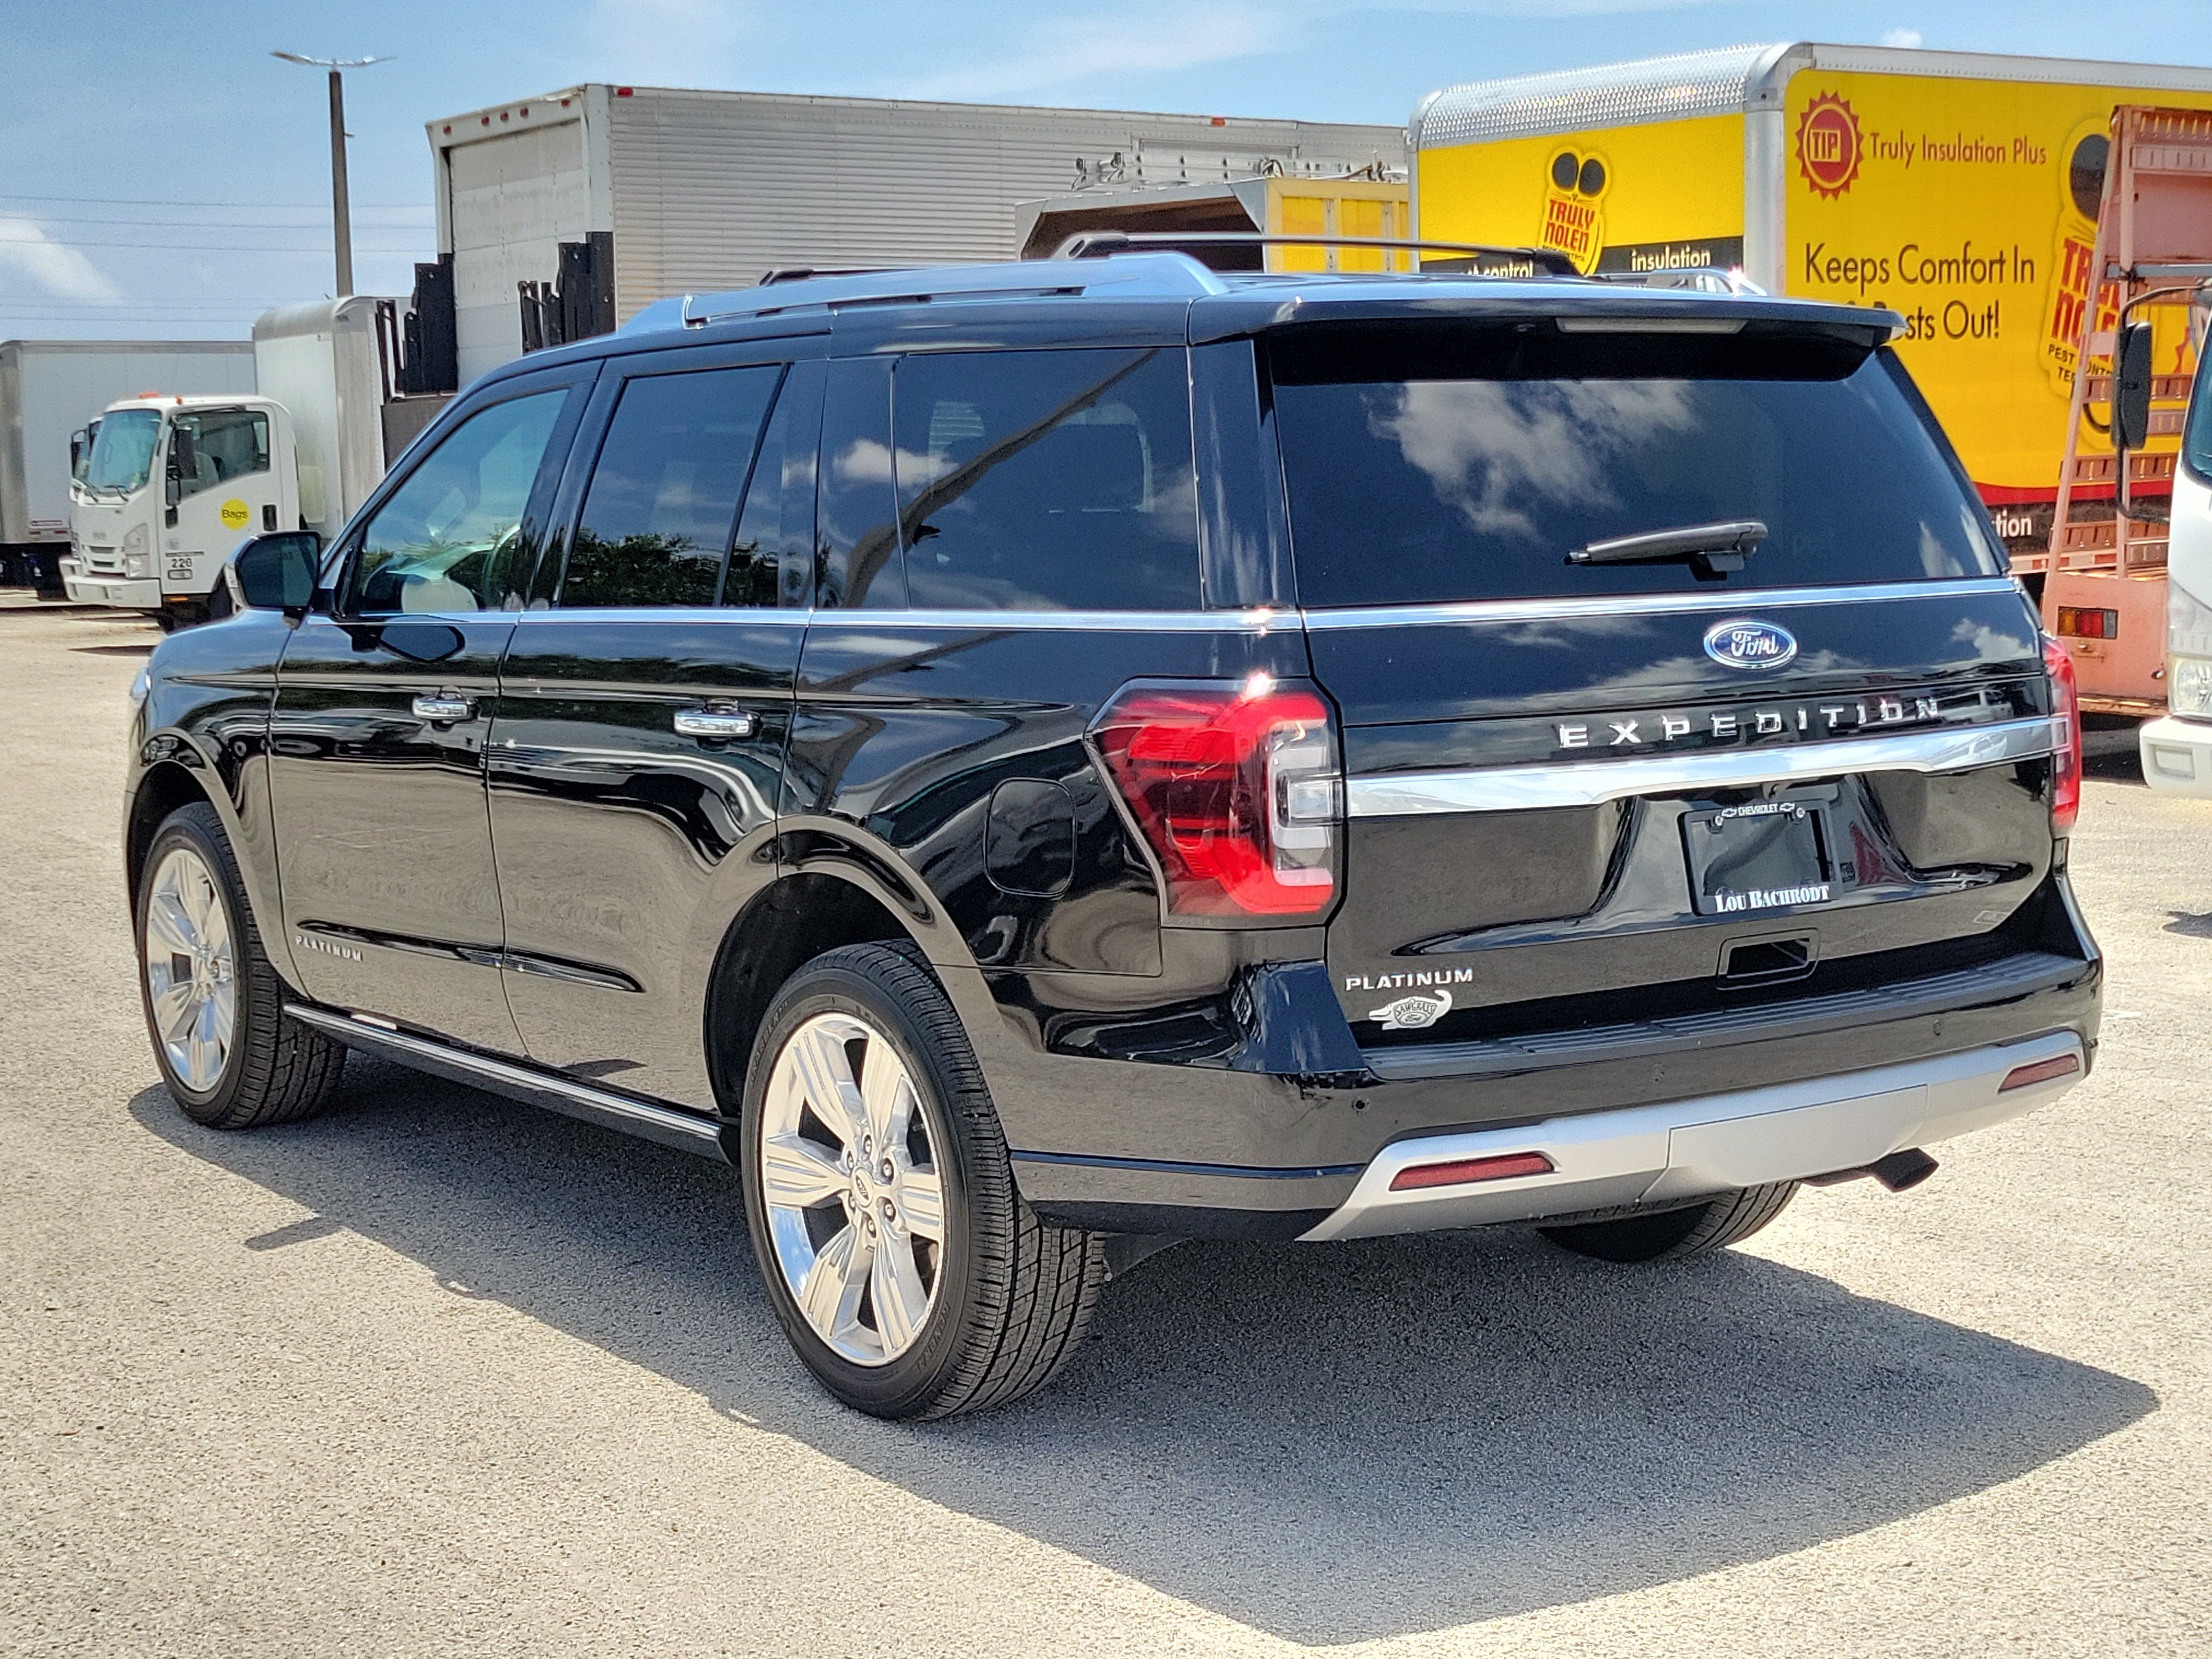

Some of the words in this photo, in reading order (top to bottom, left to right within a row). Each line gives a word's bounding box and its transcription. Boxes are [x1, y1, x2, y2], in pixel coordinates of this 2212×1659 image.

[1812, 131, 1839, 160] TIP
[1870, 130, 1915, 168] Truly
[1922, 134, 2006, 164] Insulation
[2013, 136, 2046, 165] Plus
[1549, 198, 1595, 231] TRULY
[1544, 221, 1590, 254] NOLEN
[1630, 244, 1711, 272] insulation
[1805, 242, 1890, 297] Keeps
[1898, 241, 2006, 285] Comfort
[2013, 245, 2035, 284] In
[1943, 300, 2000, 340] Out!
[2047, 343, 2075, 365] PEST
[222, 509, 248, 520] Bags
[1731, 630, 1780, 657] Ford
[1559, 697, 1939, 749] EXPEDITION
[1738, 803, 1778, 816] CHEVROLET
[295, 934, 364, 962] PLATINUM
[1345, 968, 1474, 991] PLATINUM
